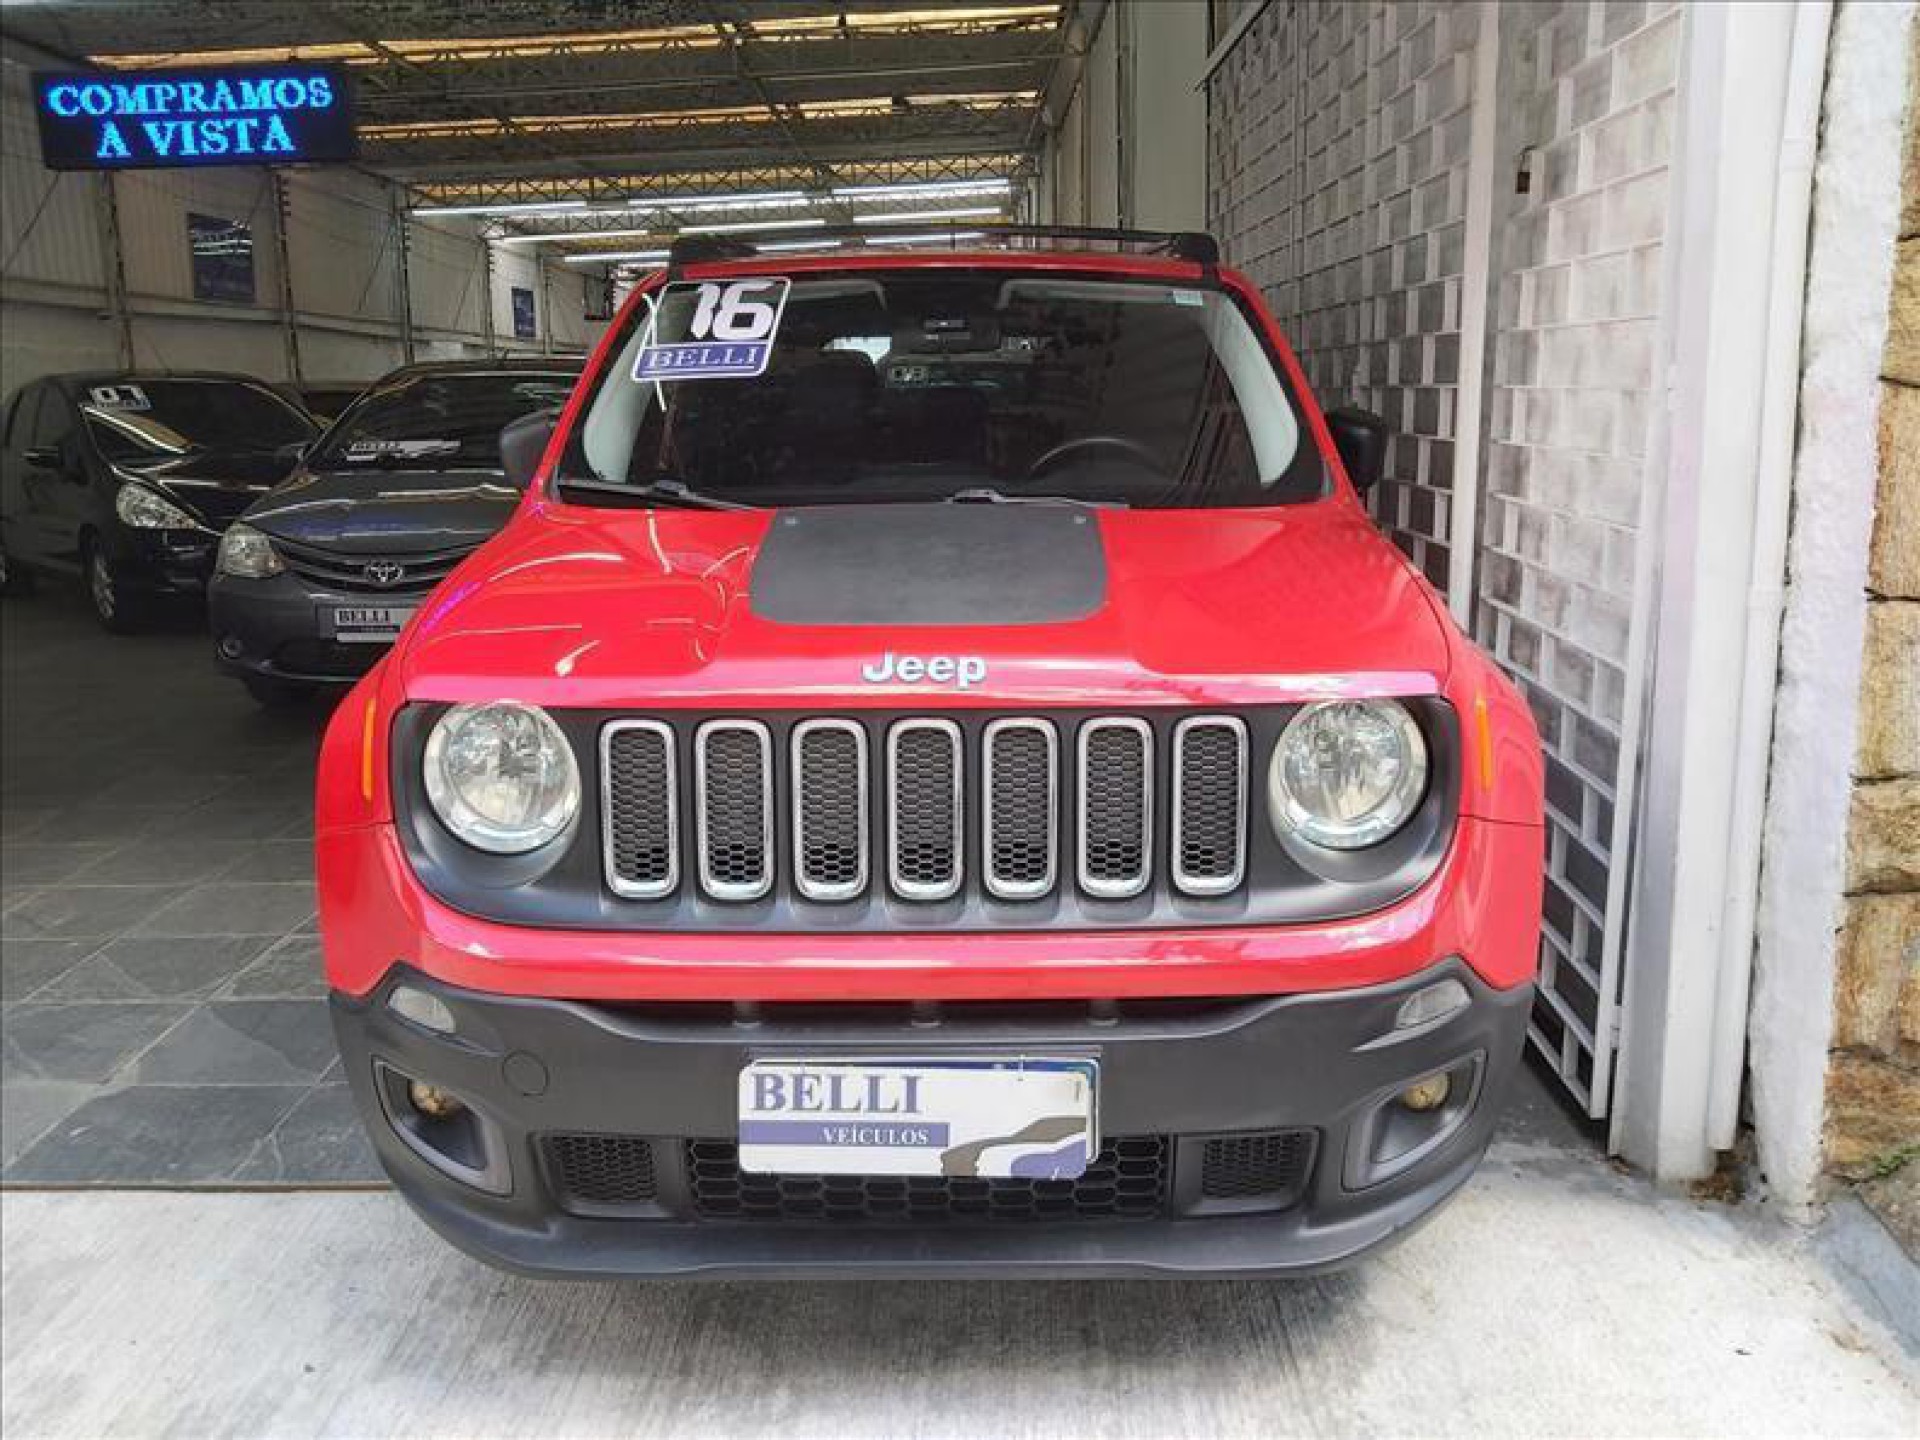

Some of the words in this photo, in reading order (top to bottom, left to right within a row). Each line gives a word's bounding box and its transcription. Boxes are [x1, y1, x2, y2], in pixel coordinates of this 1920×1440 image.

[48, 77, 333, 117] COMPRAMOS
[97, 120, 131, 158] A
[142, 114, 296, 156] VISTA
[691, 281, 774, 340] 16
[648, 347, 759, 368] BELLI
[338, 609, 389, 623] BELLI
[862, 651, 986, 689] Jeep
[751, 1073, 922, 1114] BELLI
[822, 1125, 929, 1145] VEÍCULOS
